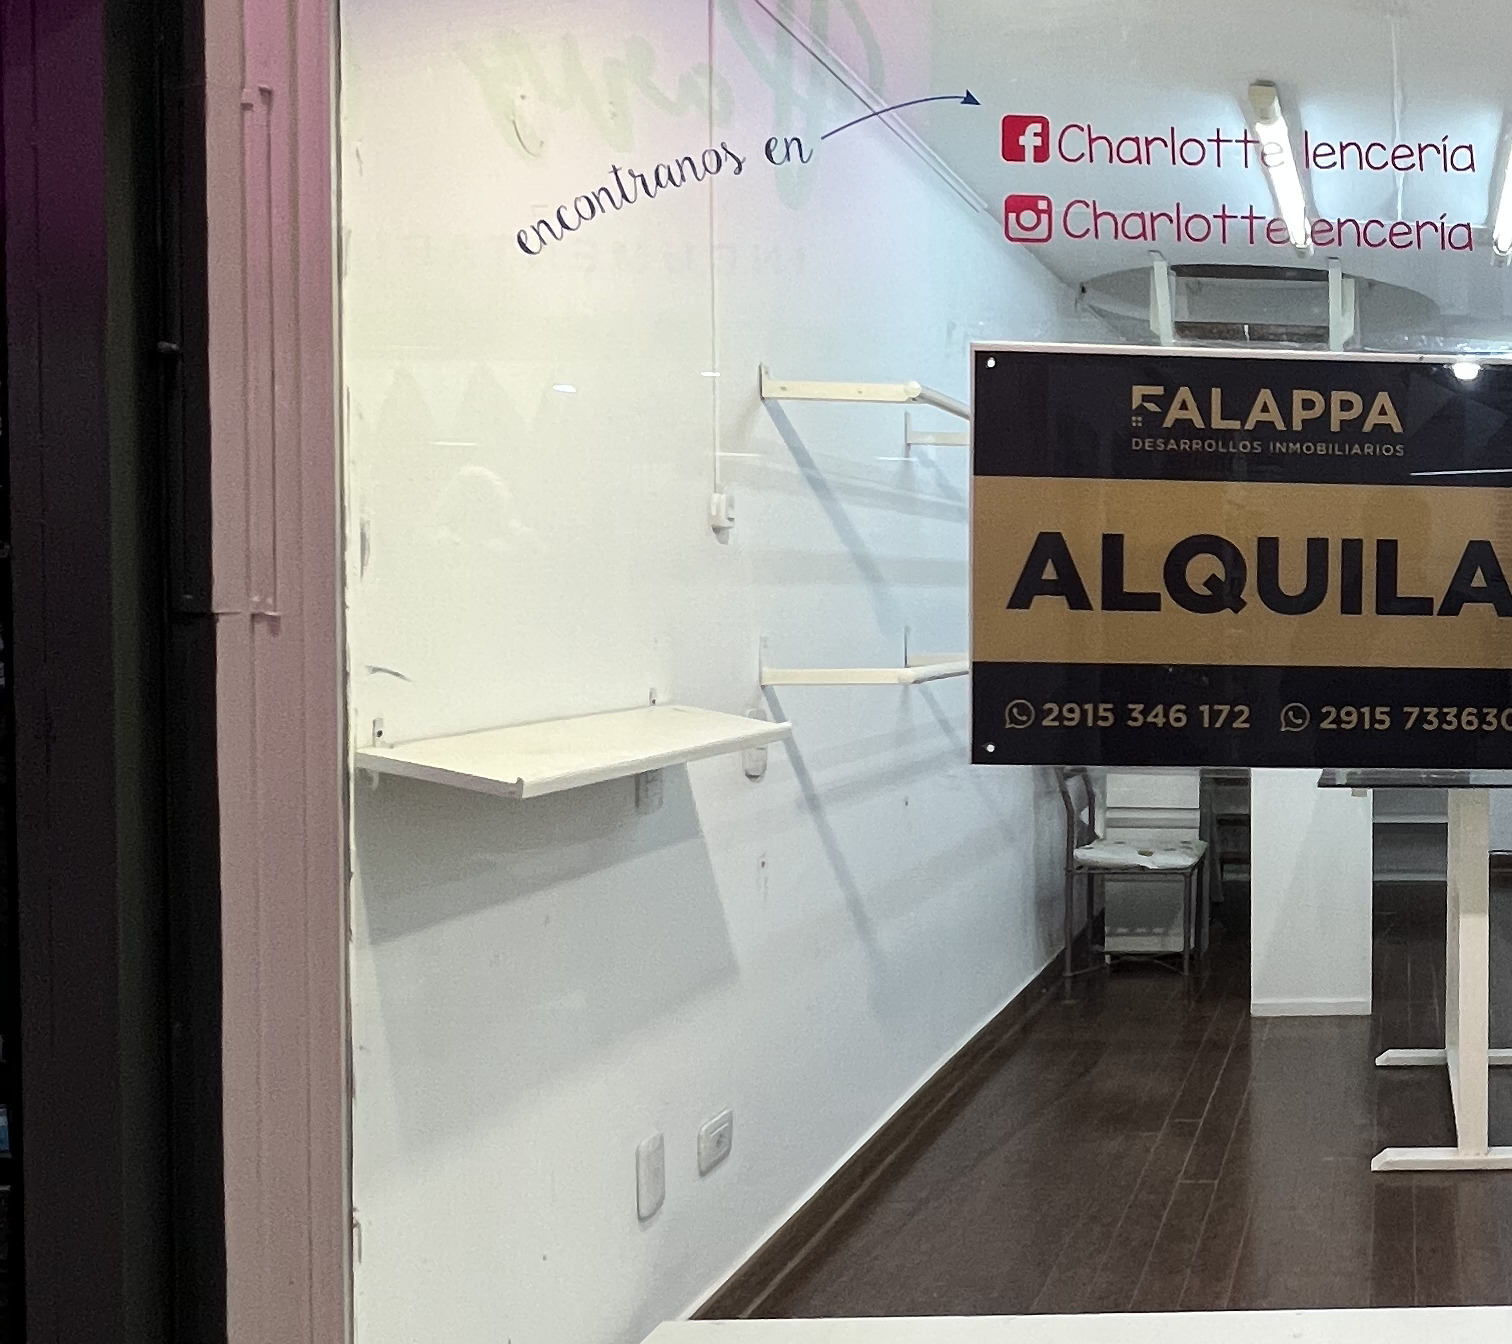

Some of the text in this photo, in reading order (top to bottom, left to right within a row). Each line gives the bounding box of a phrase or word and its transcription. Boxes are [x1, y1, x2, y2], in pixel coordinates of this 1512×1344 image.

[1057, 122, 1285, 169] Charlotte
[1303, 129, 1477, 174] lencería
[516, 135, 814, 256] encontranos en
[1062, 199, 1475, 253] Charlotte encería
[1131, 384, 1404, 434] FALAPPA
[1131, 437, 1405, 457] DESARROLLOS INMOBILIARIOS
[1040, 701, 1115, 728] 2915
[1126, 703, 1188, 729] 346
[1198, 703, 1251, 730] 172
[1319, 705, 1391, 731] 2915
